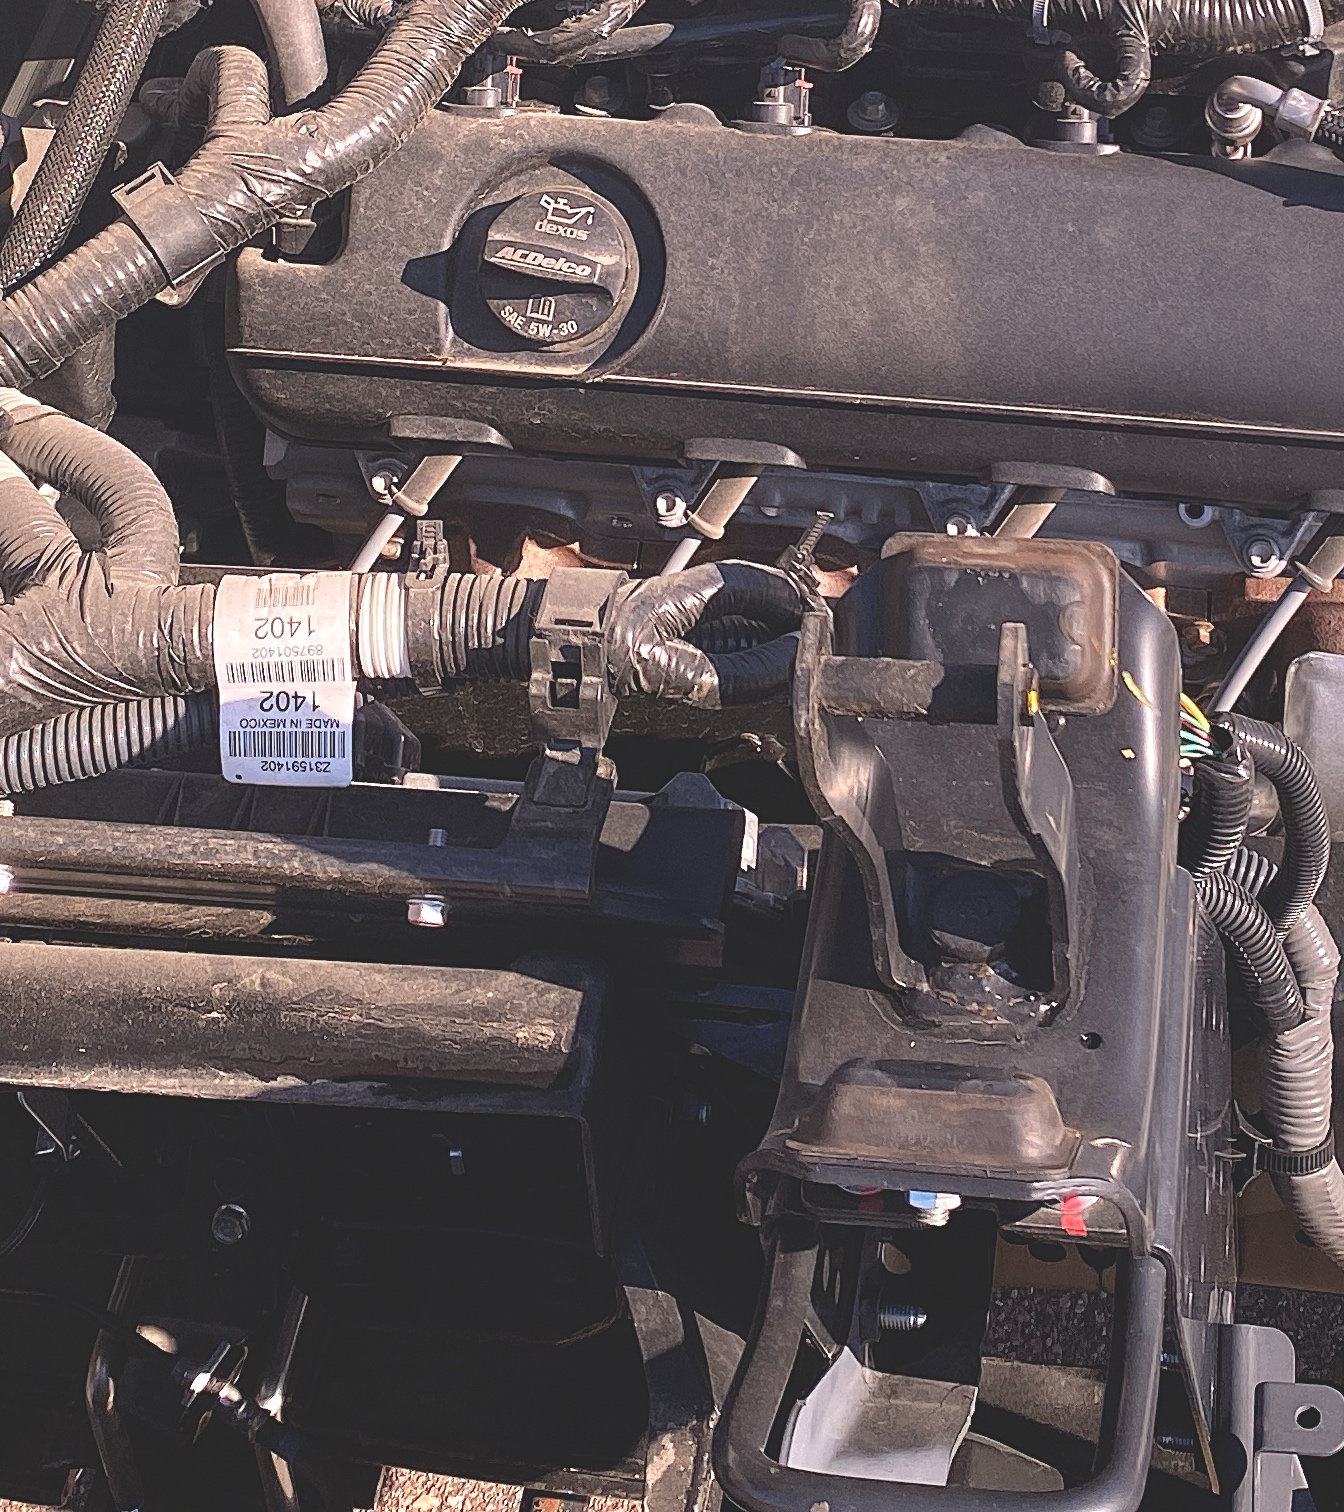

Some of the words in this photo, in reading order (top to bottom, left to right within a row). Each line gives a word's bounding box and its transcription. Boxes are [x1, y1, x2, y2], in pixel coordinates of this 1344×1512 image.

[534, 219, 591, 241] dexos
[495, 246, 592, 276] ACDelco
[500, 305, 525, 330] SAE
[528, 319, 578, 337] 5W-30
[254, 614, 317, 640] 1402
[259, 690, 321, 713] 1402
[239, 718, 287, 729] MEXICO
[289, 718, 303, 729] IN
[306, 718, 340, 729] MADE
[260, 760, 332, 773] Z31591402
